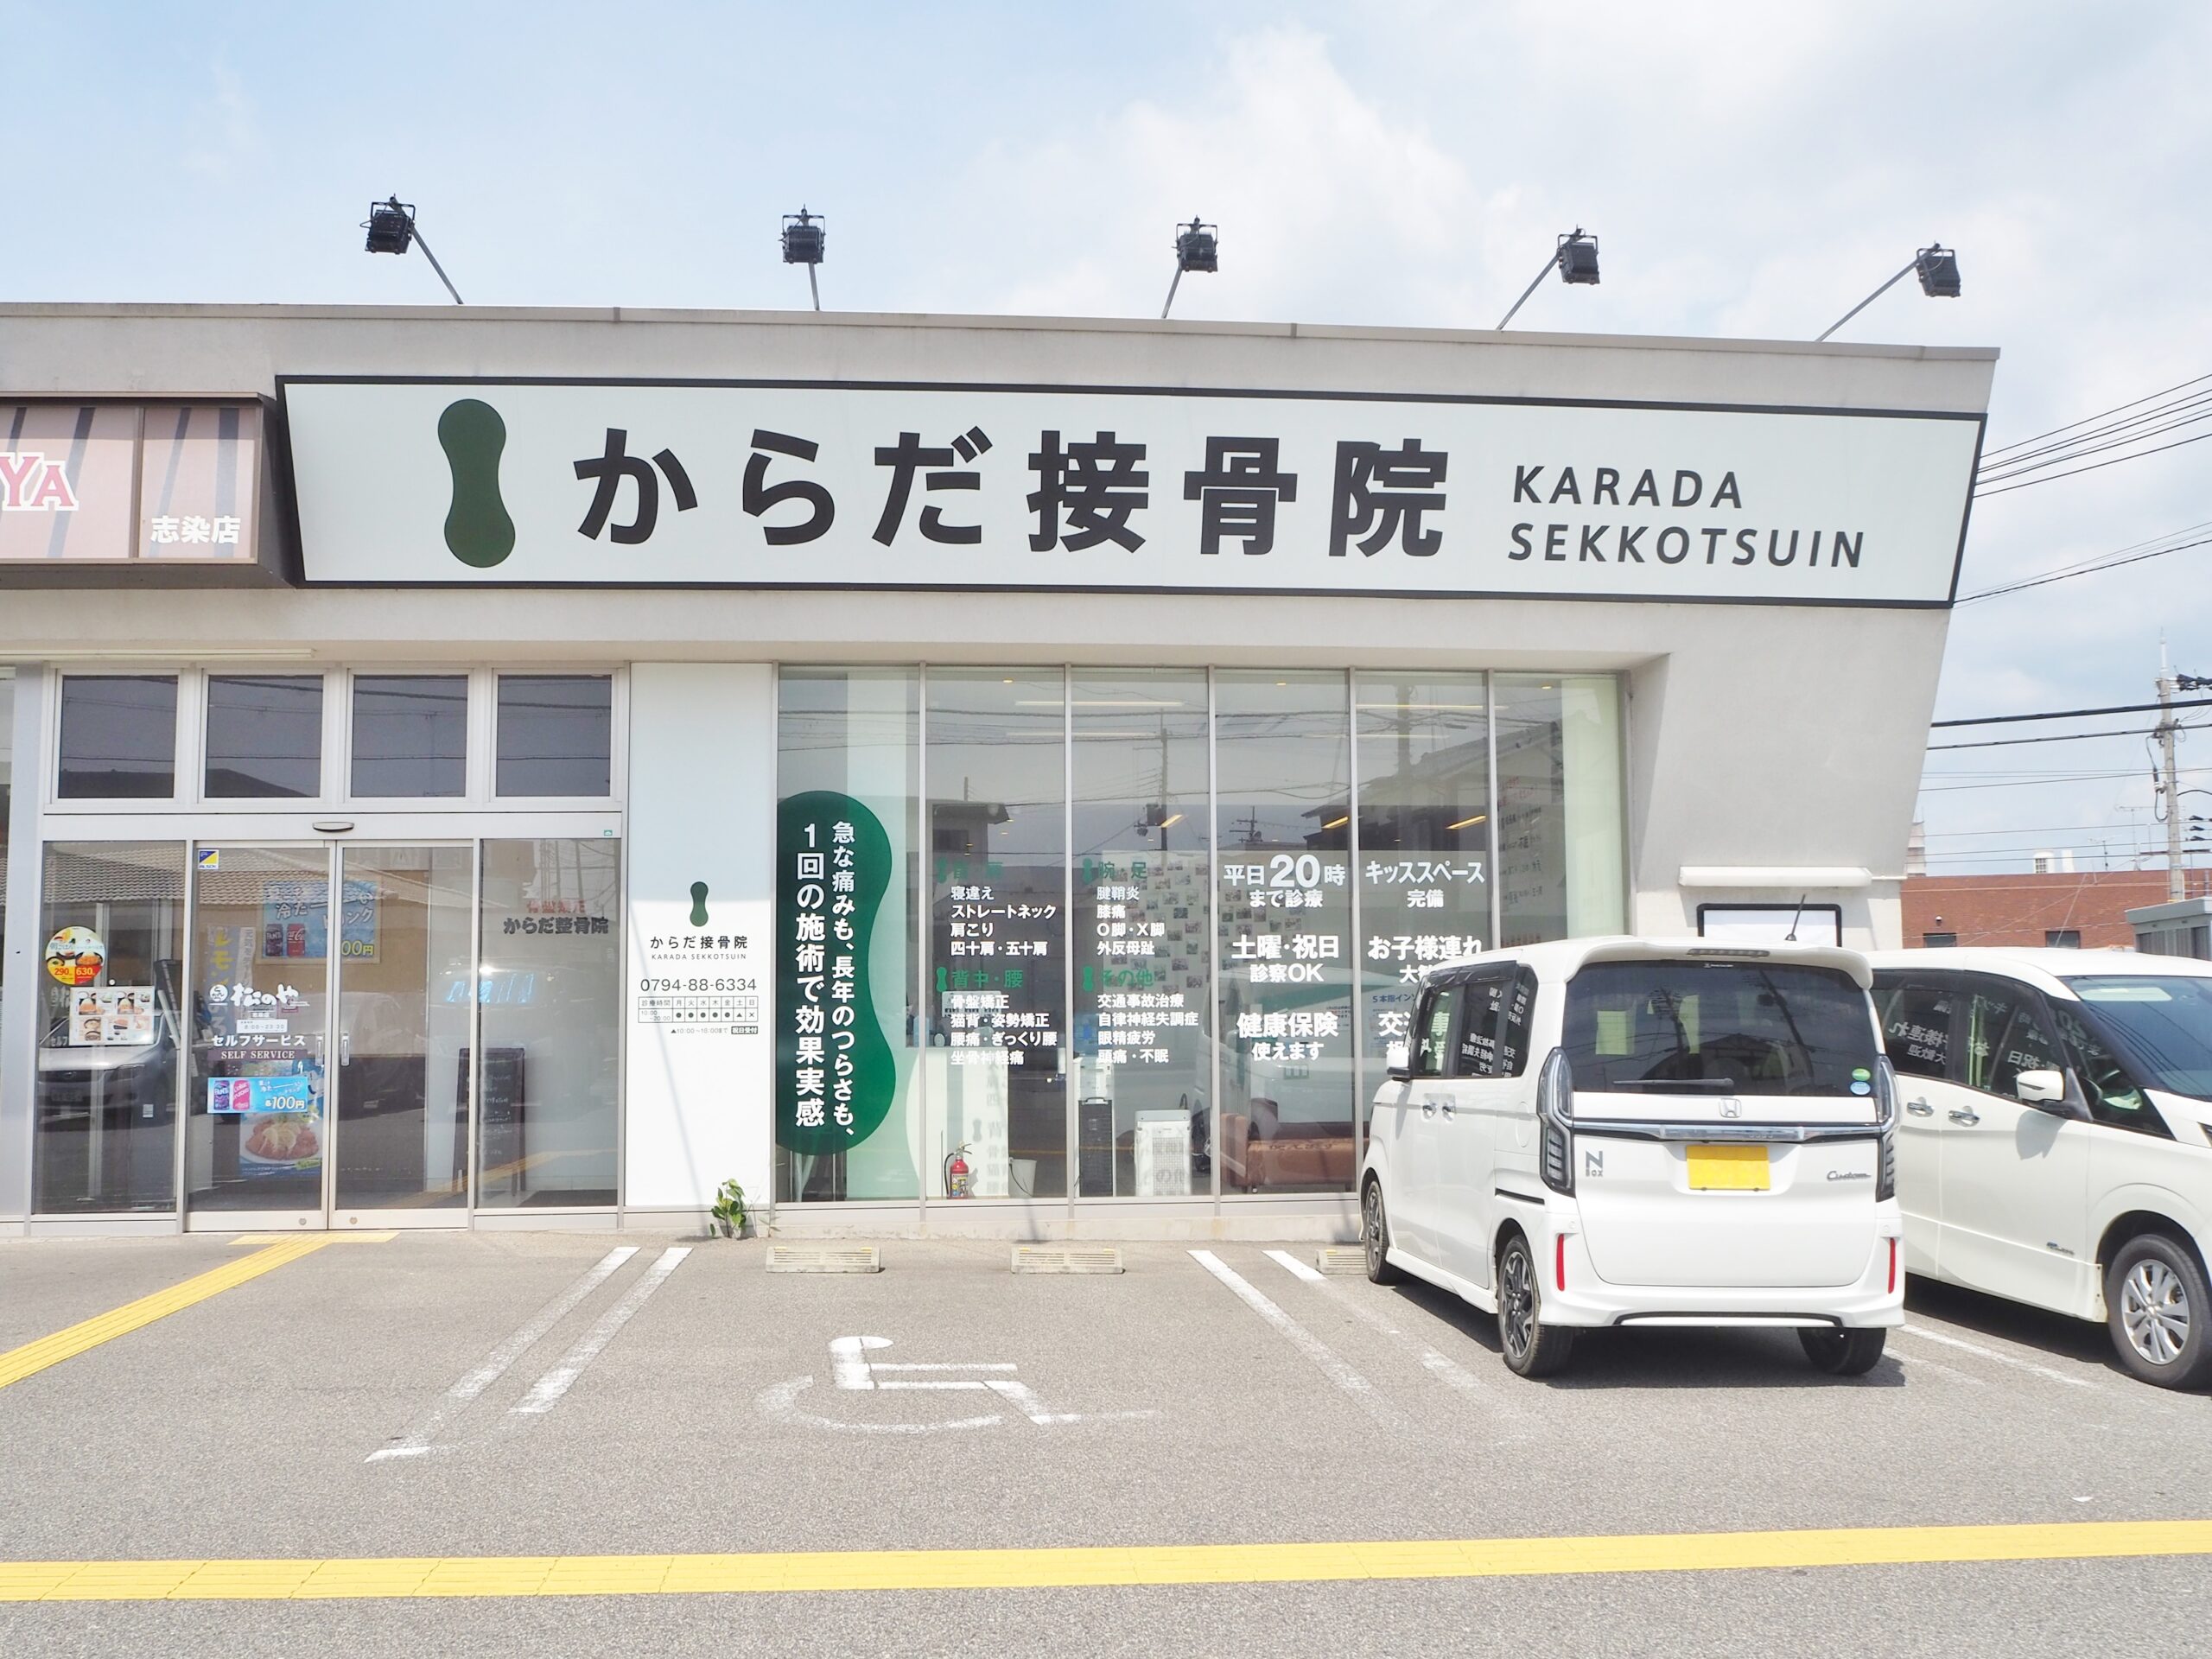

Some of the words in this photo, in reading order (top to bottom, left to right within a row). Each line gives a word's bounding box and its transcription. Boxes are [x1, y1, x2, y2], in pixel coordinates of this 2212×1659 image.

[574, 424, 1449, 557] からだ接骨院
[1513, 465, 1743, 509] KARADA
[150, 515, 241, 544] 志染店
[1508, 523, 1864, 568] SEKKOTSUIN
[1224, 854, 1346, 888] 平日20時
[950, 886, 995, 900] 寝違え
[1096, 886, 1140, 900] 腱鞘炎
[1249, 889, 1324, 907] まで診療
[1407, 889, 1444, 908] 完備
[951, 904, 1056, 919] ストレートネック
[1096, 904, 1126, 918] 膝痛
[950, 922, 994, 938] 肩こり
[650, 936, 747, 950] からだ接骨院
[950, 940, 1048, 956] 四十肩・五十肩
[1096, 940, 1155, 955] 外反母趾
[1231, 934, 1338, 960] 土曜・祝日
[1368, 935, 1482, 961] お子様連れ
[795, 823, 825, 1128] 1回の施術で効果実感
[831, 821, 855, 1136] 急な痛みも、長年のつらさも、
[952, 969, 1023, 988] 背中・腰
[1100, 969, 1154, 987] その他
[1249, 963, 1324, 983] 診察OK
[640, 978, 757, 991] 0794-88-6334
[950, 995, 1009, 1009] 骨盤矯正
[1097, 994, 1185, 1009] 交通事故治療
[950, 1013, 1050, 1028] 猫背・姿勢矯正
[1097, 1011, 1199, 1027] 自律神経失調症
[1236, 1012, 1338, 1038] 健康保険
[212, 1034, 306, 1047] セルフサービス
[950, 1031, 1058, 1046] 腰痛・ぎっくり腰
[1097, 1030, 1155, 1046] 眼精疲労
[221, 1051, 247, 1059] SELF
[251, 1050, 296, 1059] SERVICE
[950, 1050, 1025, 1065] 坐骨神経痛
[1097, 1048, 1169, 1064] 頭痛・不眠
[1251, 1041, 1325, 1061] 使えます
[1586, 1150, 1603, 1168] N
